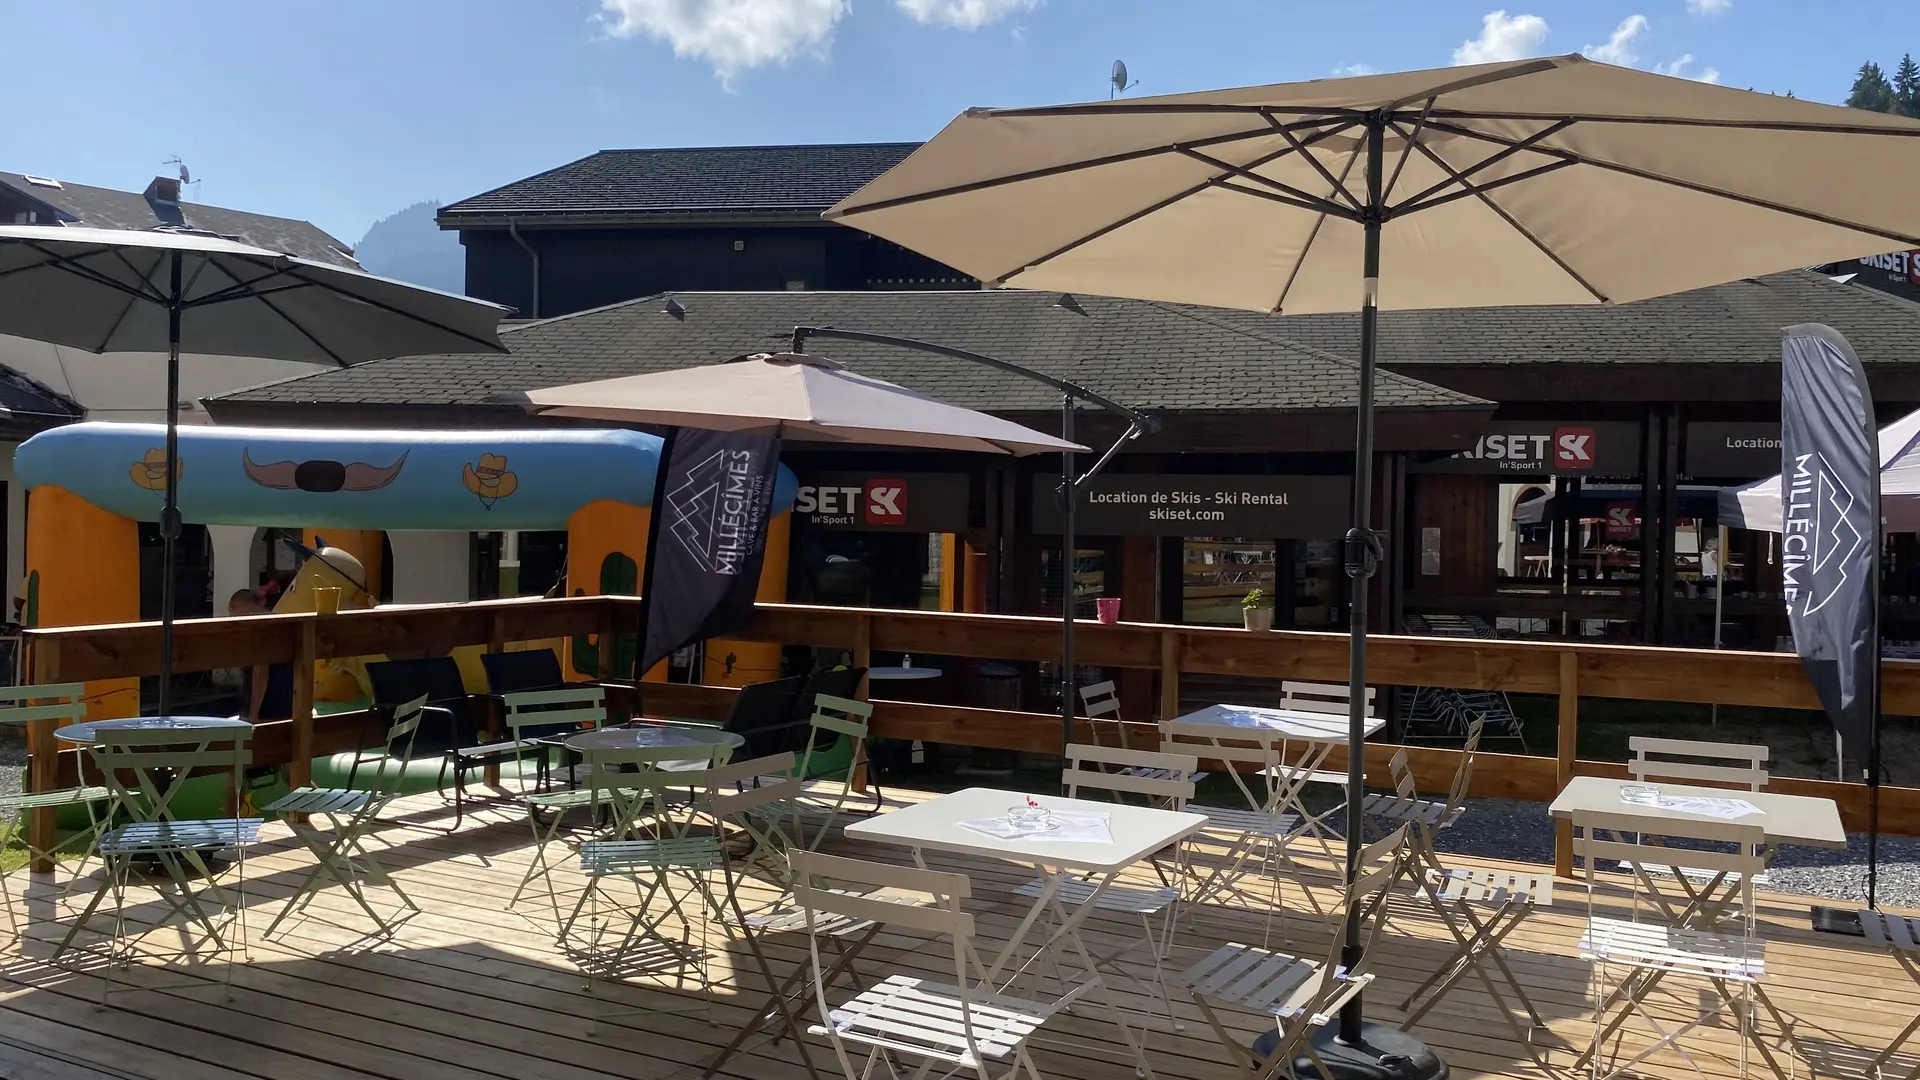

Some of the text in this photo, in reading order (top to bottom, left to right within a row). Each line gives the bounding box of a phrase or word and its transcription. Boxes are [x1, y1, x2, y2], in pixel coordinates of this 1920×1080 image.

[1451, 434, 1551, 460] ISET
[1726, 437, 1782, 449] Location
[1500, 461, 1535, 471] In'Sport
[791, 486, 862, 514] SET
[1089, 491, 1147, 504] Location
[1151, 491, 1168, 504] de
[1171, 491, 1201, 504] Skis
[1215, 492, 1237, 505] Ski
[1241, 492, 1289, 505] Rental
[811, 515, 848, 525] In'Sport
[1149, 507, 1225, 521] skiset.com
